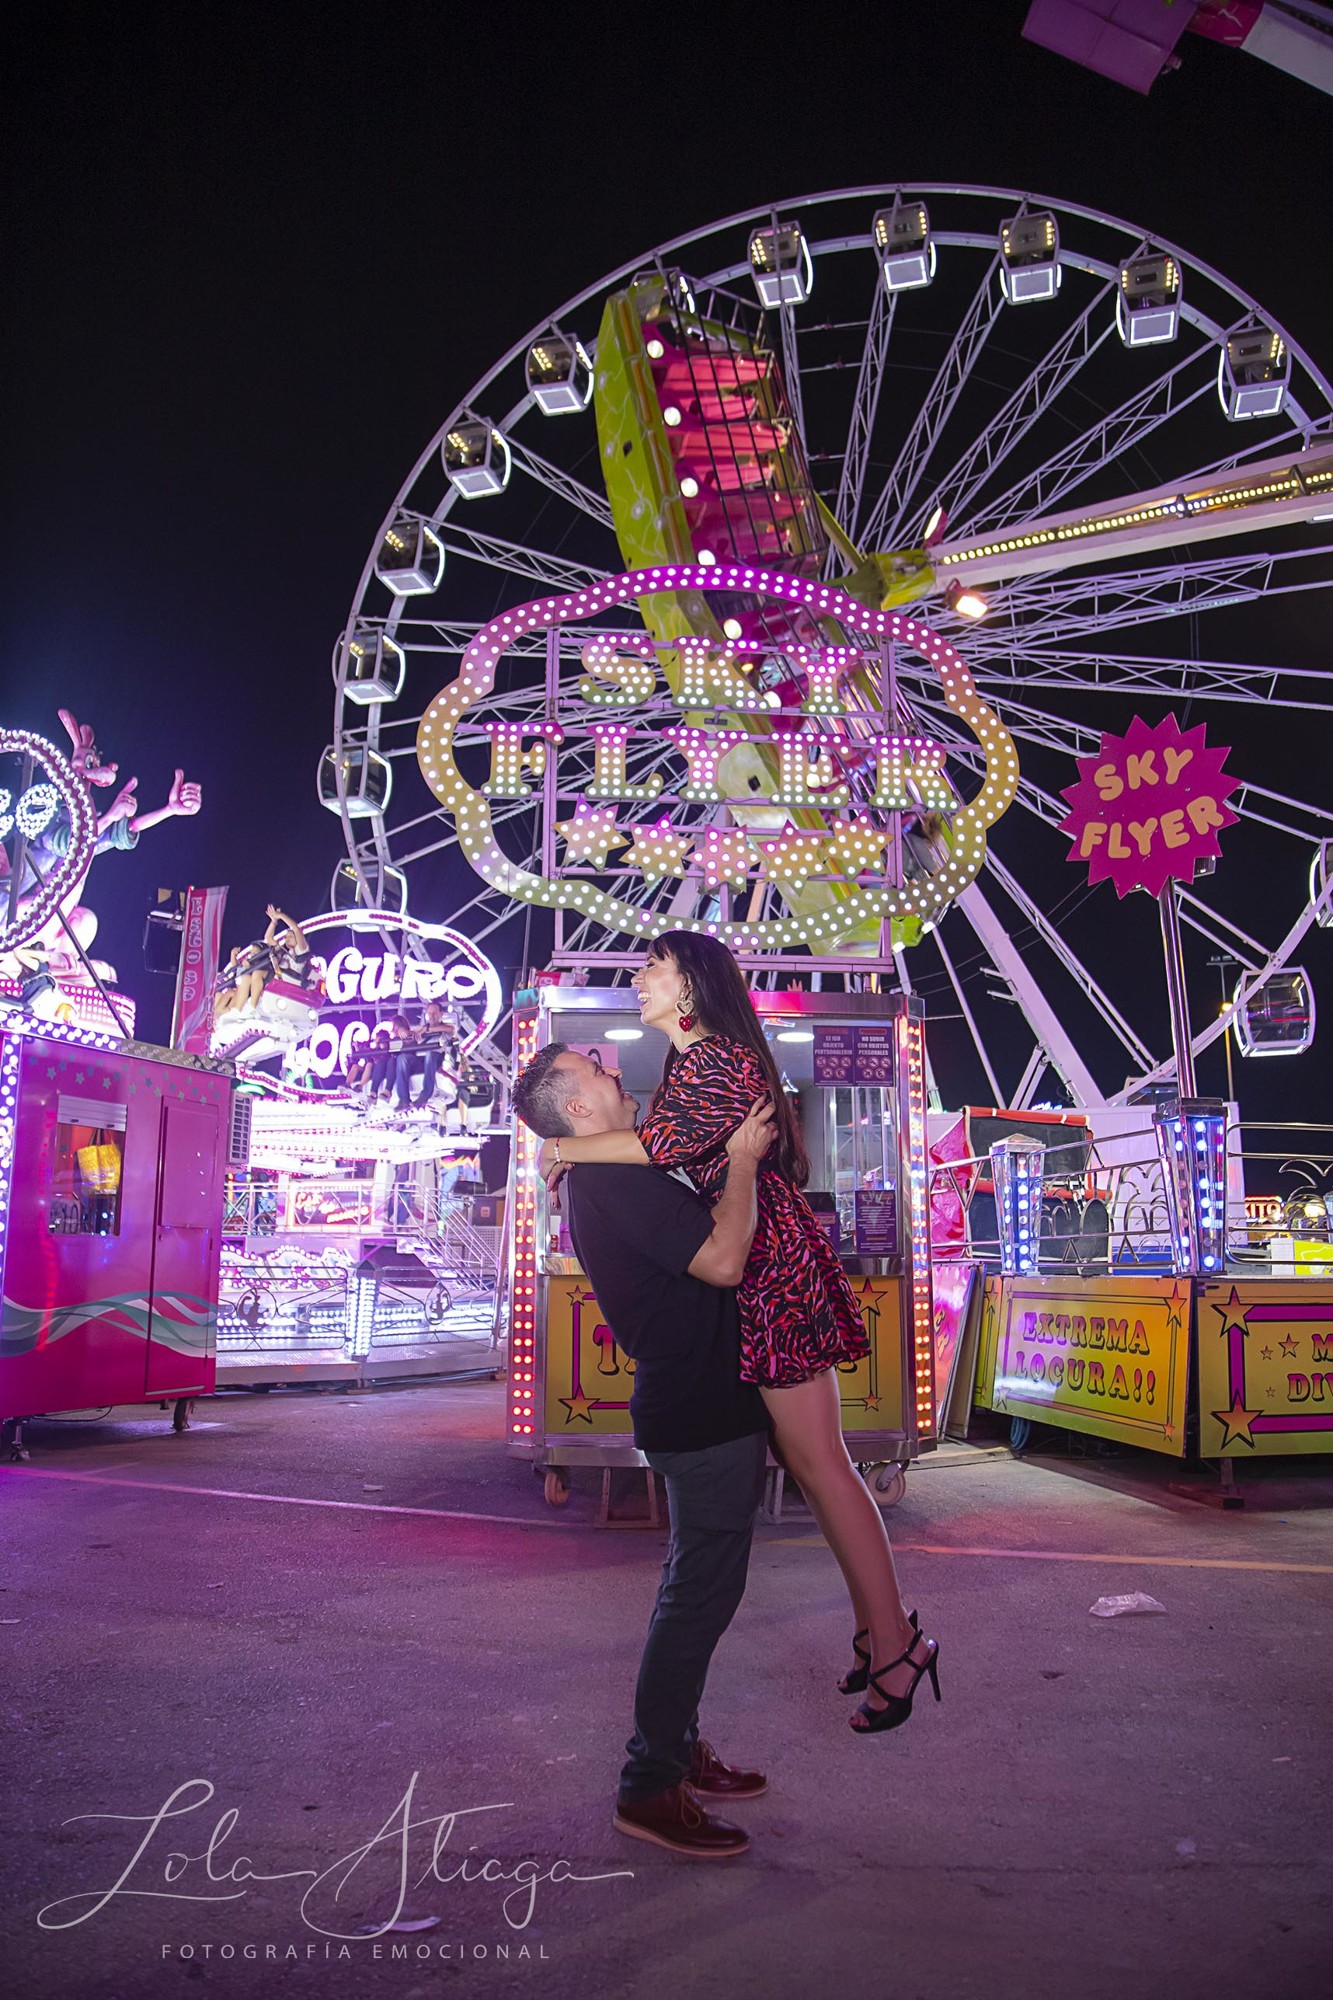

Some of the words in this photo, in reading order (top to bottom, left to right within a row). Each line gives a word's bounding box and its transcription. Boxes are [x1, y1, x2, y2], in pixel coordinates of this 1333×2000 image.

[579, 633, 864, 715] SKY
[481, 721, 960, 812] FLYER
[1094, 747, 1193, 801] SKY
[1080, 796, 1224, 859] FLYER
[1023, 1312, 1150, 1355] EXTREMA
[1014, 1351, 1156, 1405] LOCURA!!
